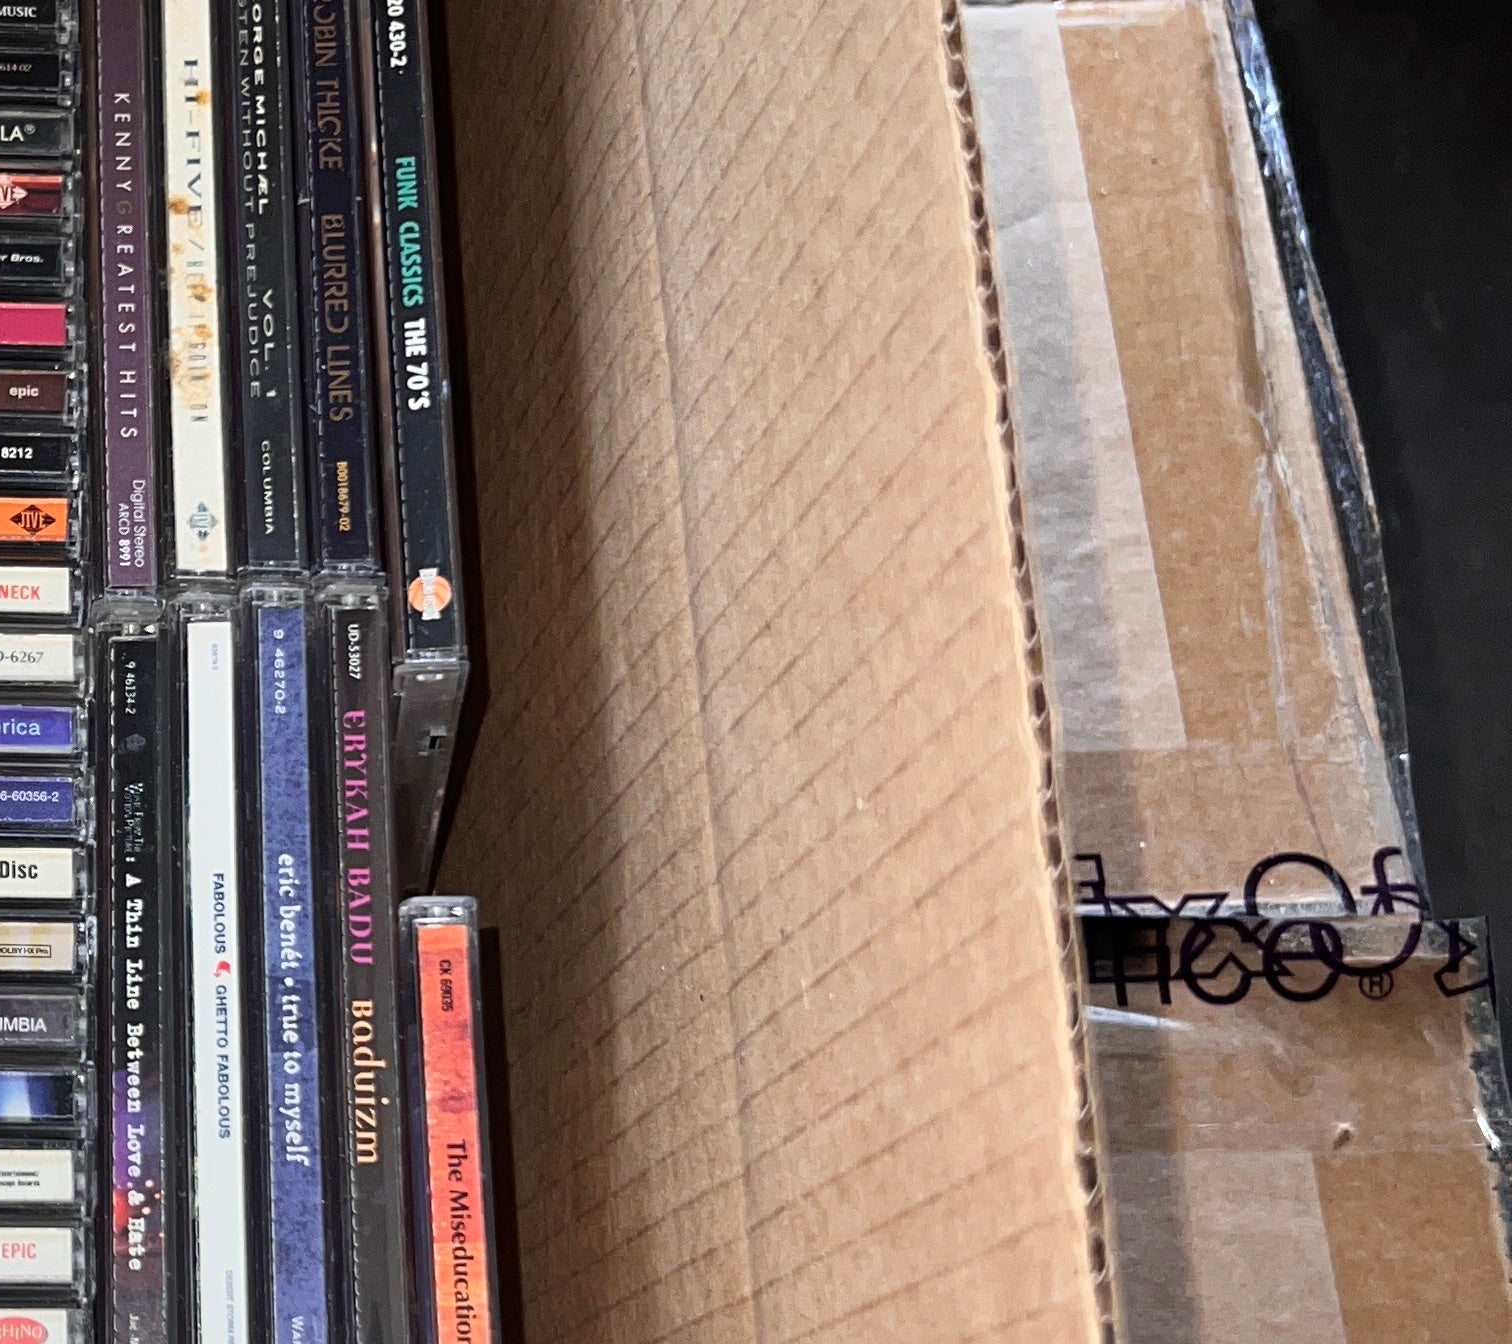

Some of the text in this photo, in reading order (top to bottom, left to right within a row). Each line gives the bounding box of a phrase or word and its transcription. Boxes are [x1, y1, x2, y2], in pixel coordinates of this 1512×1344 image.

[115, 93, 137, 439] KENNY HITS
[262, 289, 275, 372] VOL.
[320, 214, 353, 422] BLURRED LINES
[395, 156, 426, 356] FUNK CLASSICS THE
[0, 446, 33, 459] 8212
[9, 385, 39, 399] epic
[244, 223, 274, 535] PREJUDICE COLUMBIA
[118, 503, 131, 566] ARCD 8991
[131, 480, 146, 567] Digital Stereo
[342, 624, 374, 965] UD-53027 ERYKAH BADU
[213, 873, 230, 1139] FABOLOUS GHETTO FABOLOUS
[273, 648, 308, 1167] 46270-2 eric myself
[126, 959, 145, 1177] Line Between Love
[1, 1243, 37, 1260] EPIC
